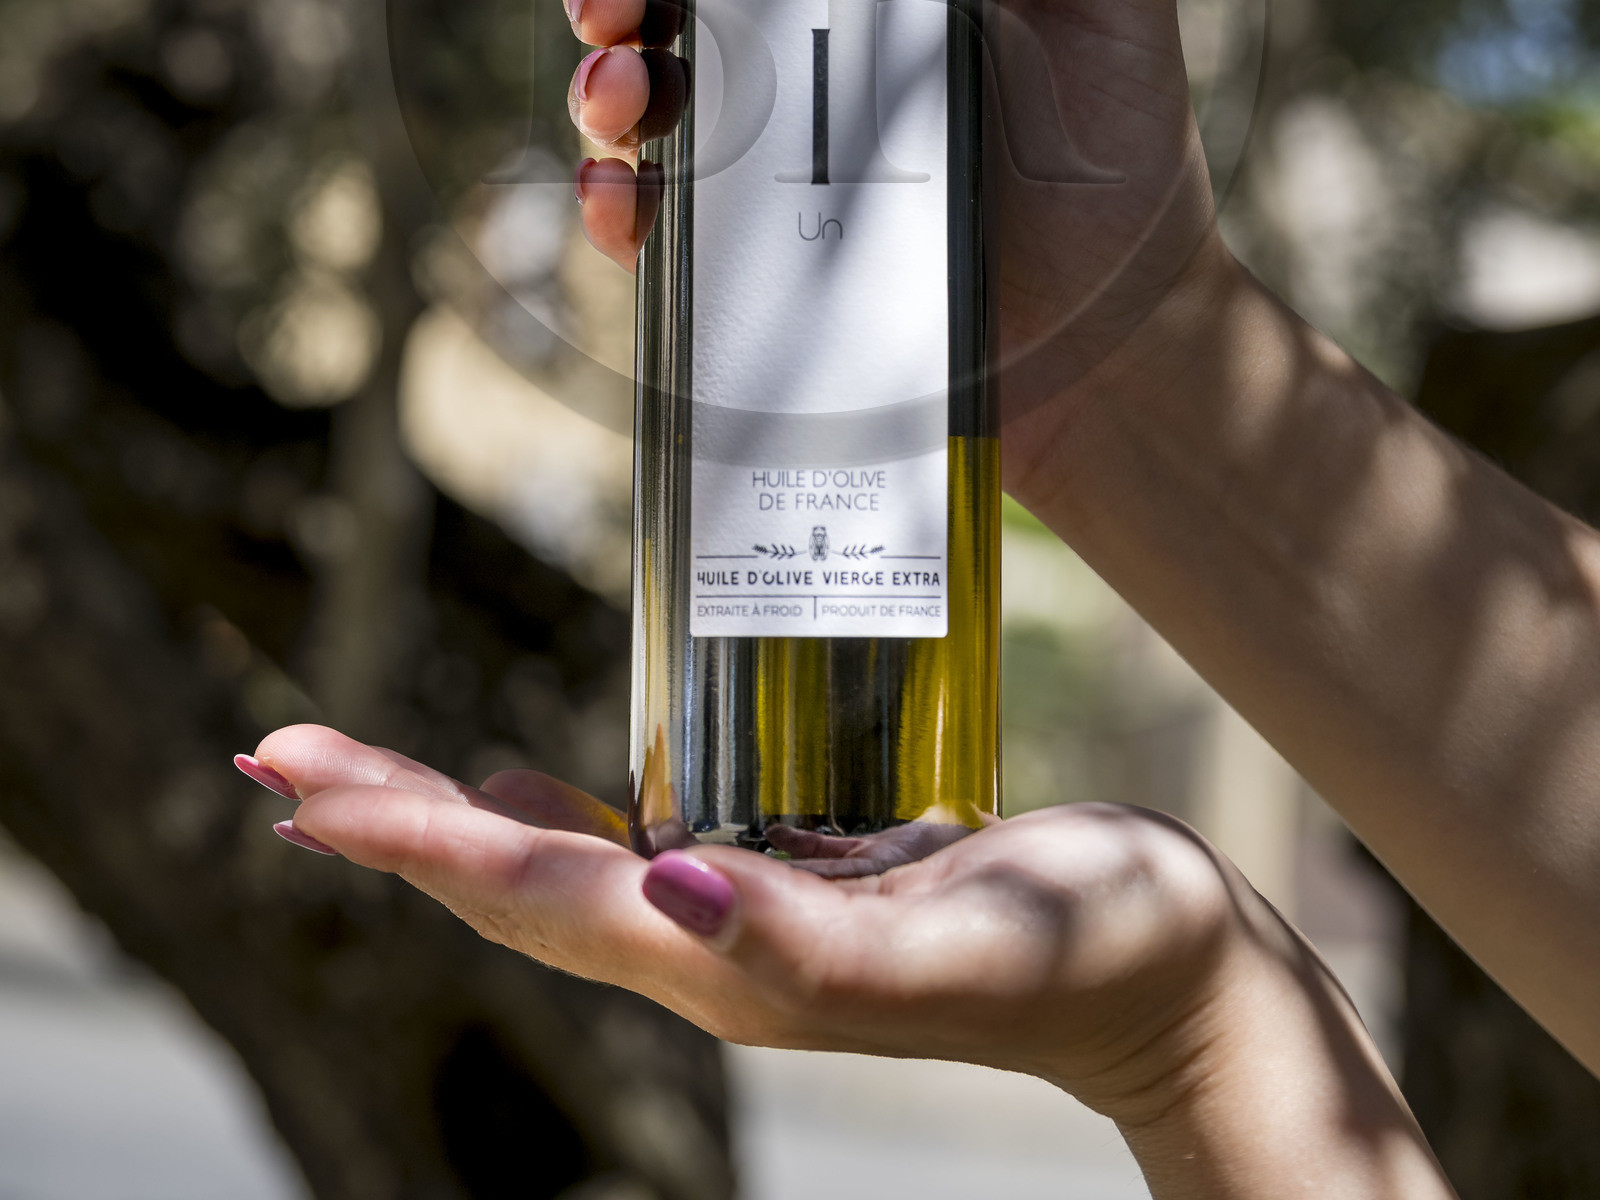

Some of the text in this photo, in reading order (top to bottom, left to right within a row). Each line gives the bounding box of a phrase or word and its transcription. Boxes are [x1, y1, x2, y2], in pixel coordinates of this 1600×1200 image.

[798, 211, 843, 241] Un
[752, 470, 887, 489] HUILE D'OLIVE
[759, 492, 880, 511] DE FRANCE
[697, 570, 941, 587] HUILE D'OLIVE VIERGE EXTRA
[697, 604, 749, 617] EXTRAITE
[763, 604, 803, 617] FROID
[822, 604, 942, 618] PRODUIT DE FRANCE
